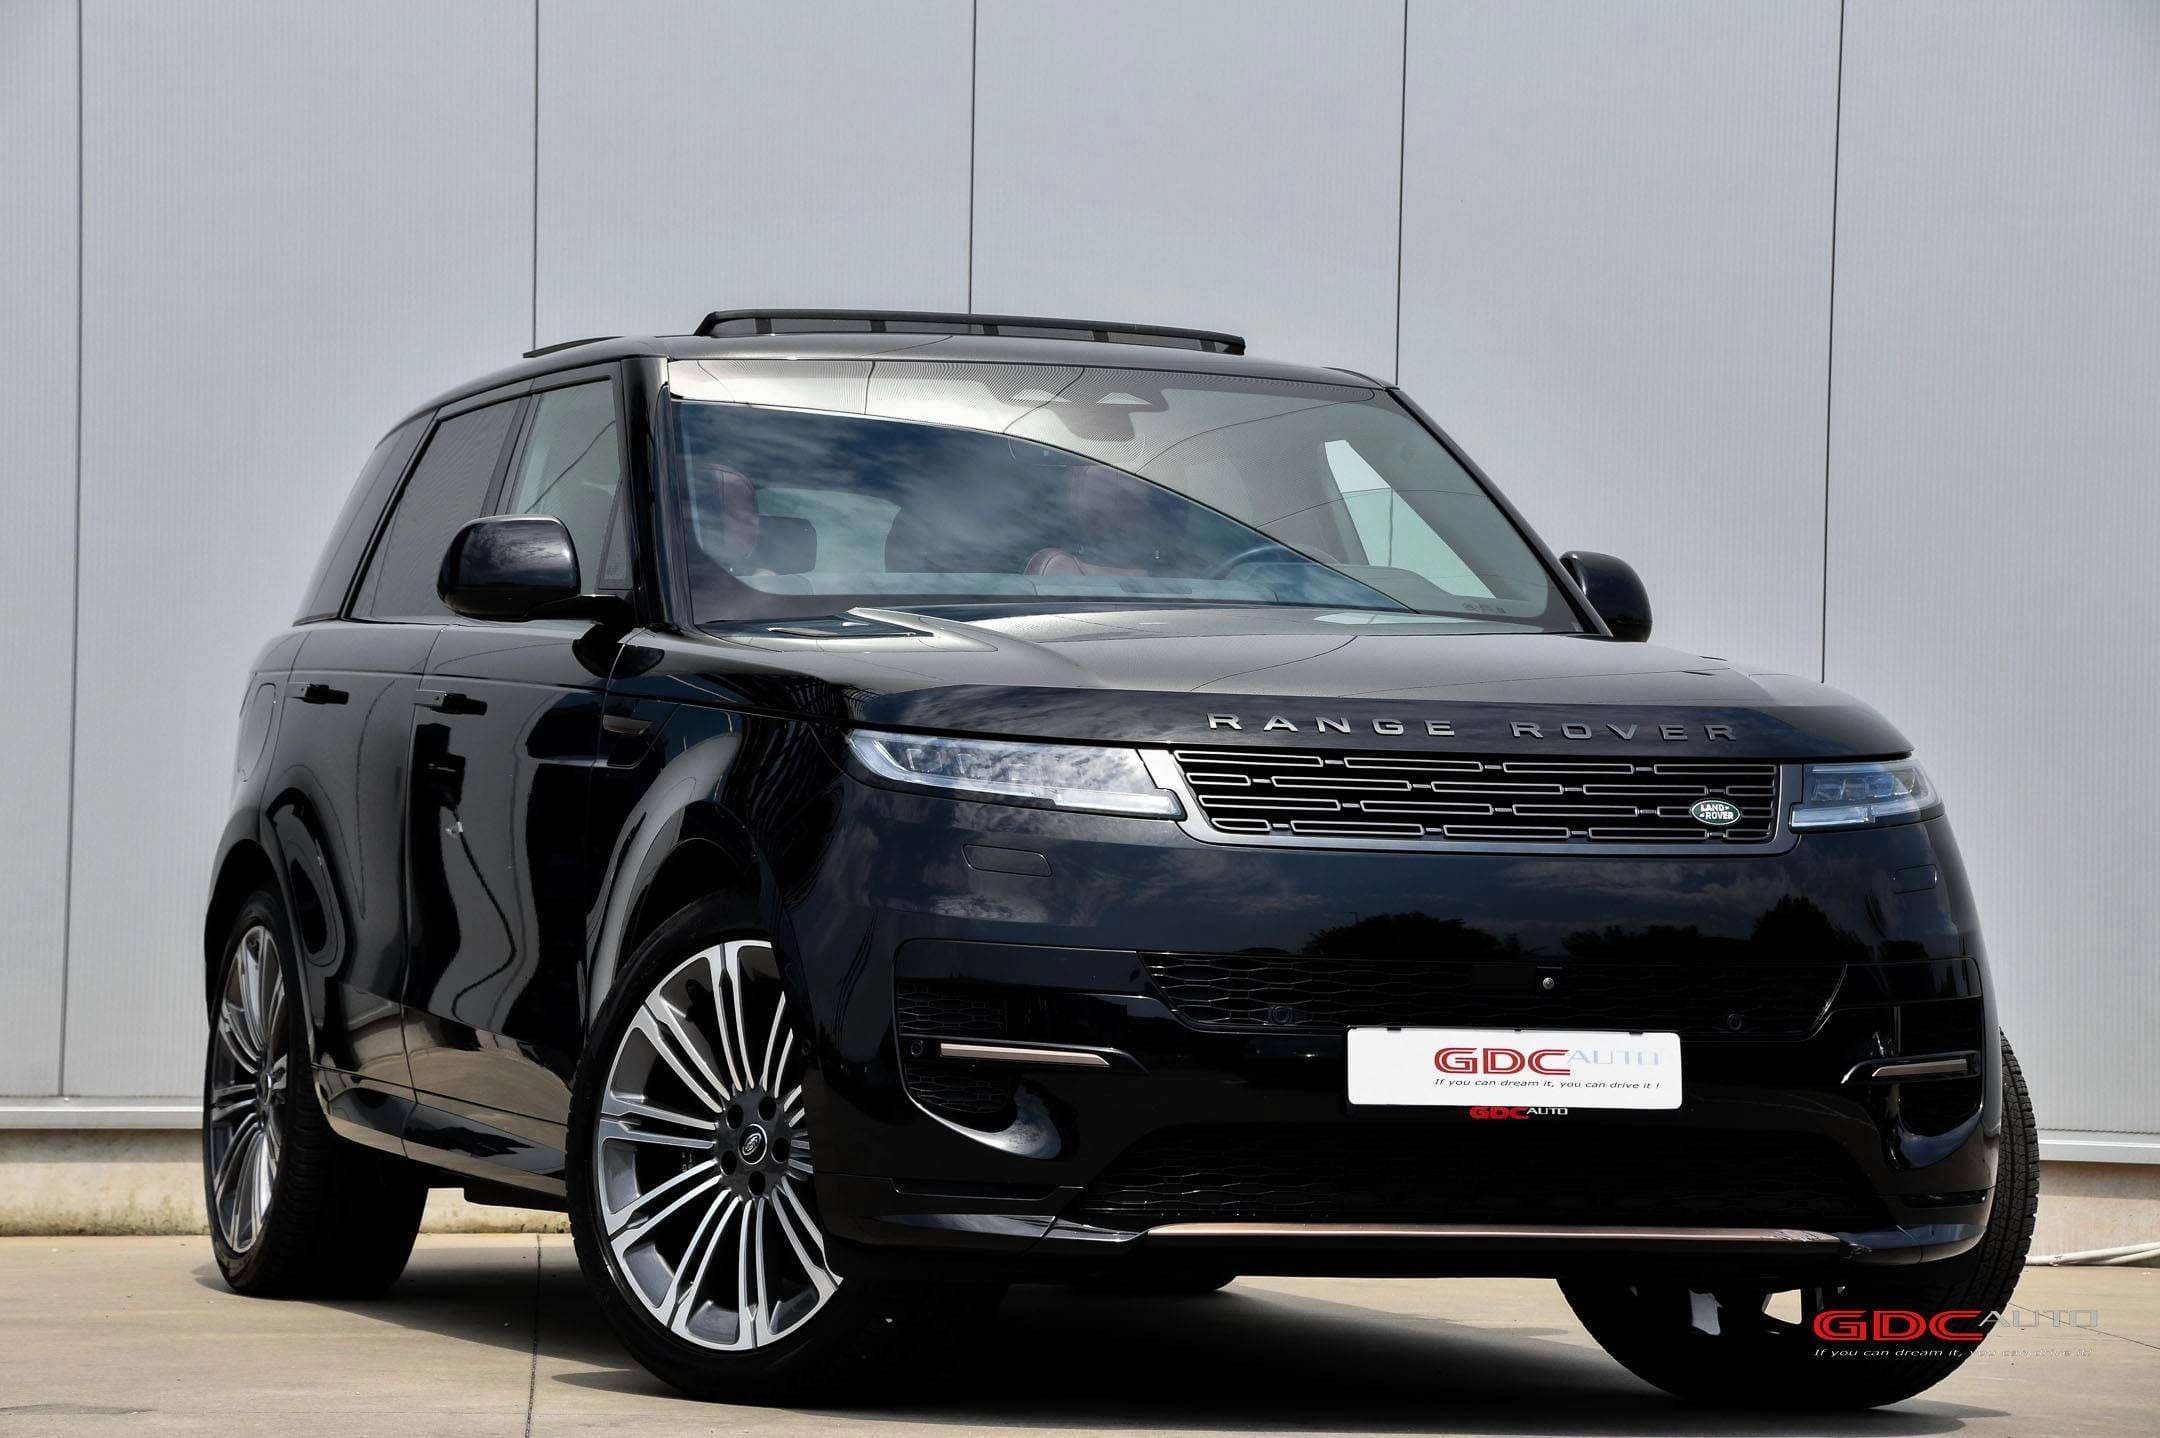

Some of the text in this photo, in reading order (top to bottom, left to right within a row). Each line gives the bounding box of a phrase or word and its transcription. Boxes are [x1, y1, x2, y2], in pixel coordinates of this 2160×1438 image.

[1206, 711, 1736, 741] RANGE ROVER
[1700, 803, 1725, 812] LAND
[1705, 811, 1734, 820] ROVER
[1434, 1047, 1660, 1076] GDC AUTO
[1435, 1078, 1445, 1086] If
[1448, 1079, 1471, 1088] you
[1500, 1080, 1539, 1088] dream
[1560, 1081, 1581, 1089] you
[1585, 1081, 1606, 1089] can
[1609, 1081, 1639, 1090] drive
[1469, 1105, 1568, 1120] GDC AUTO
